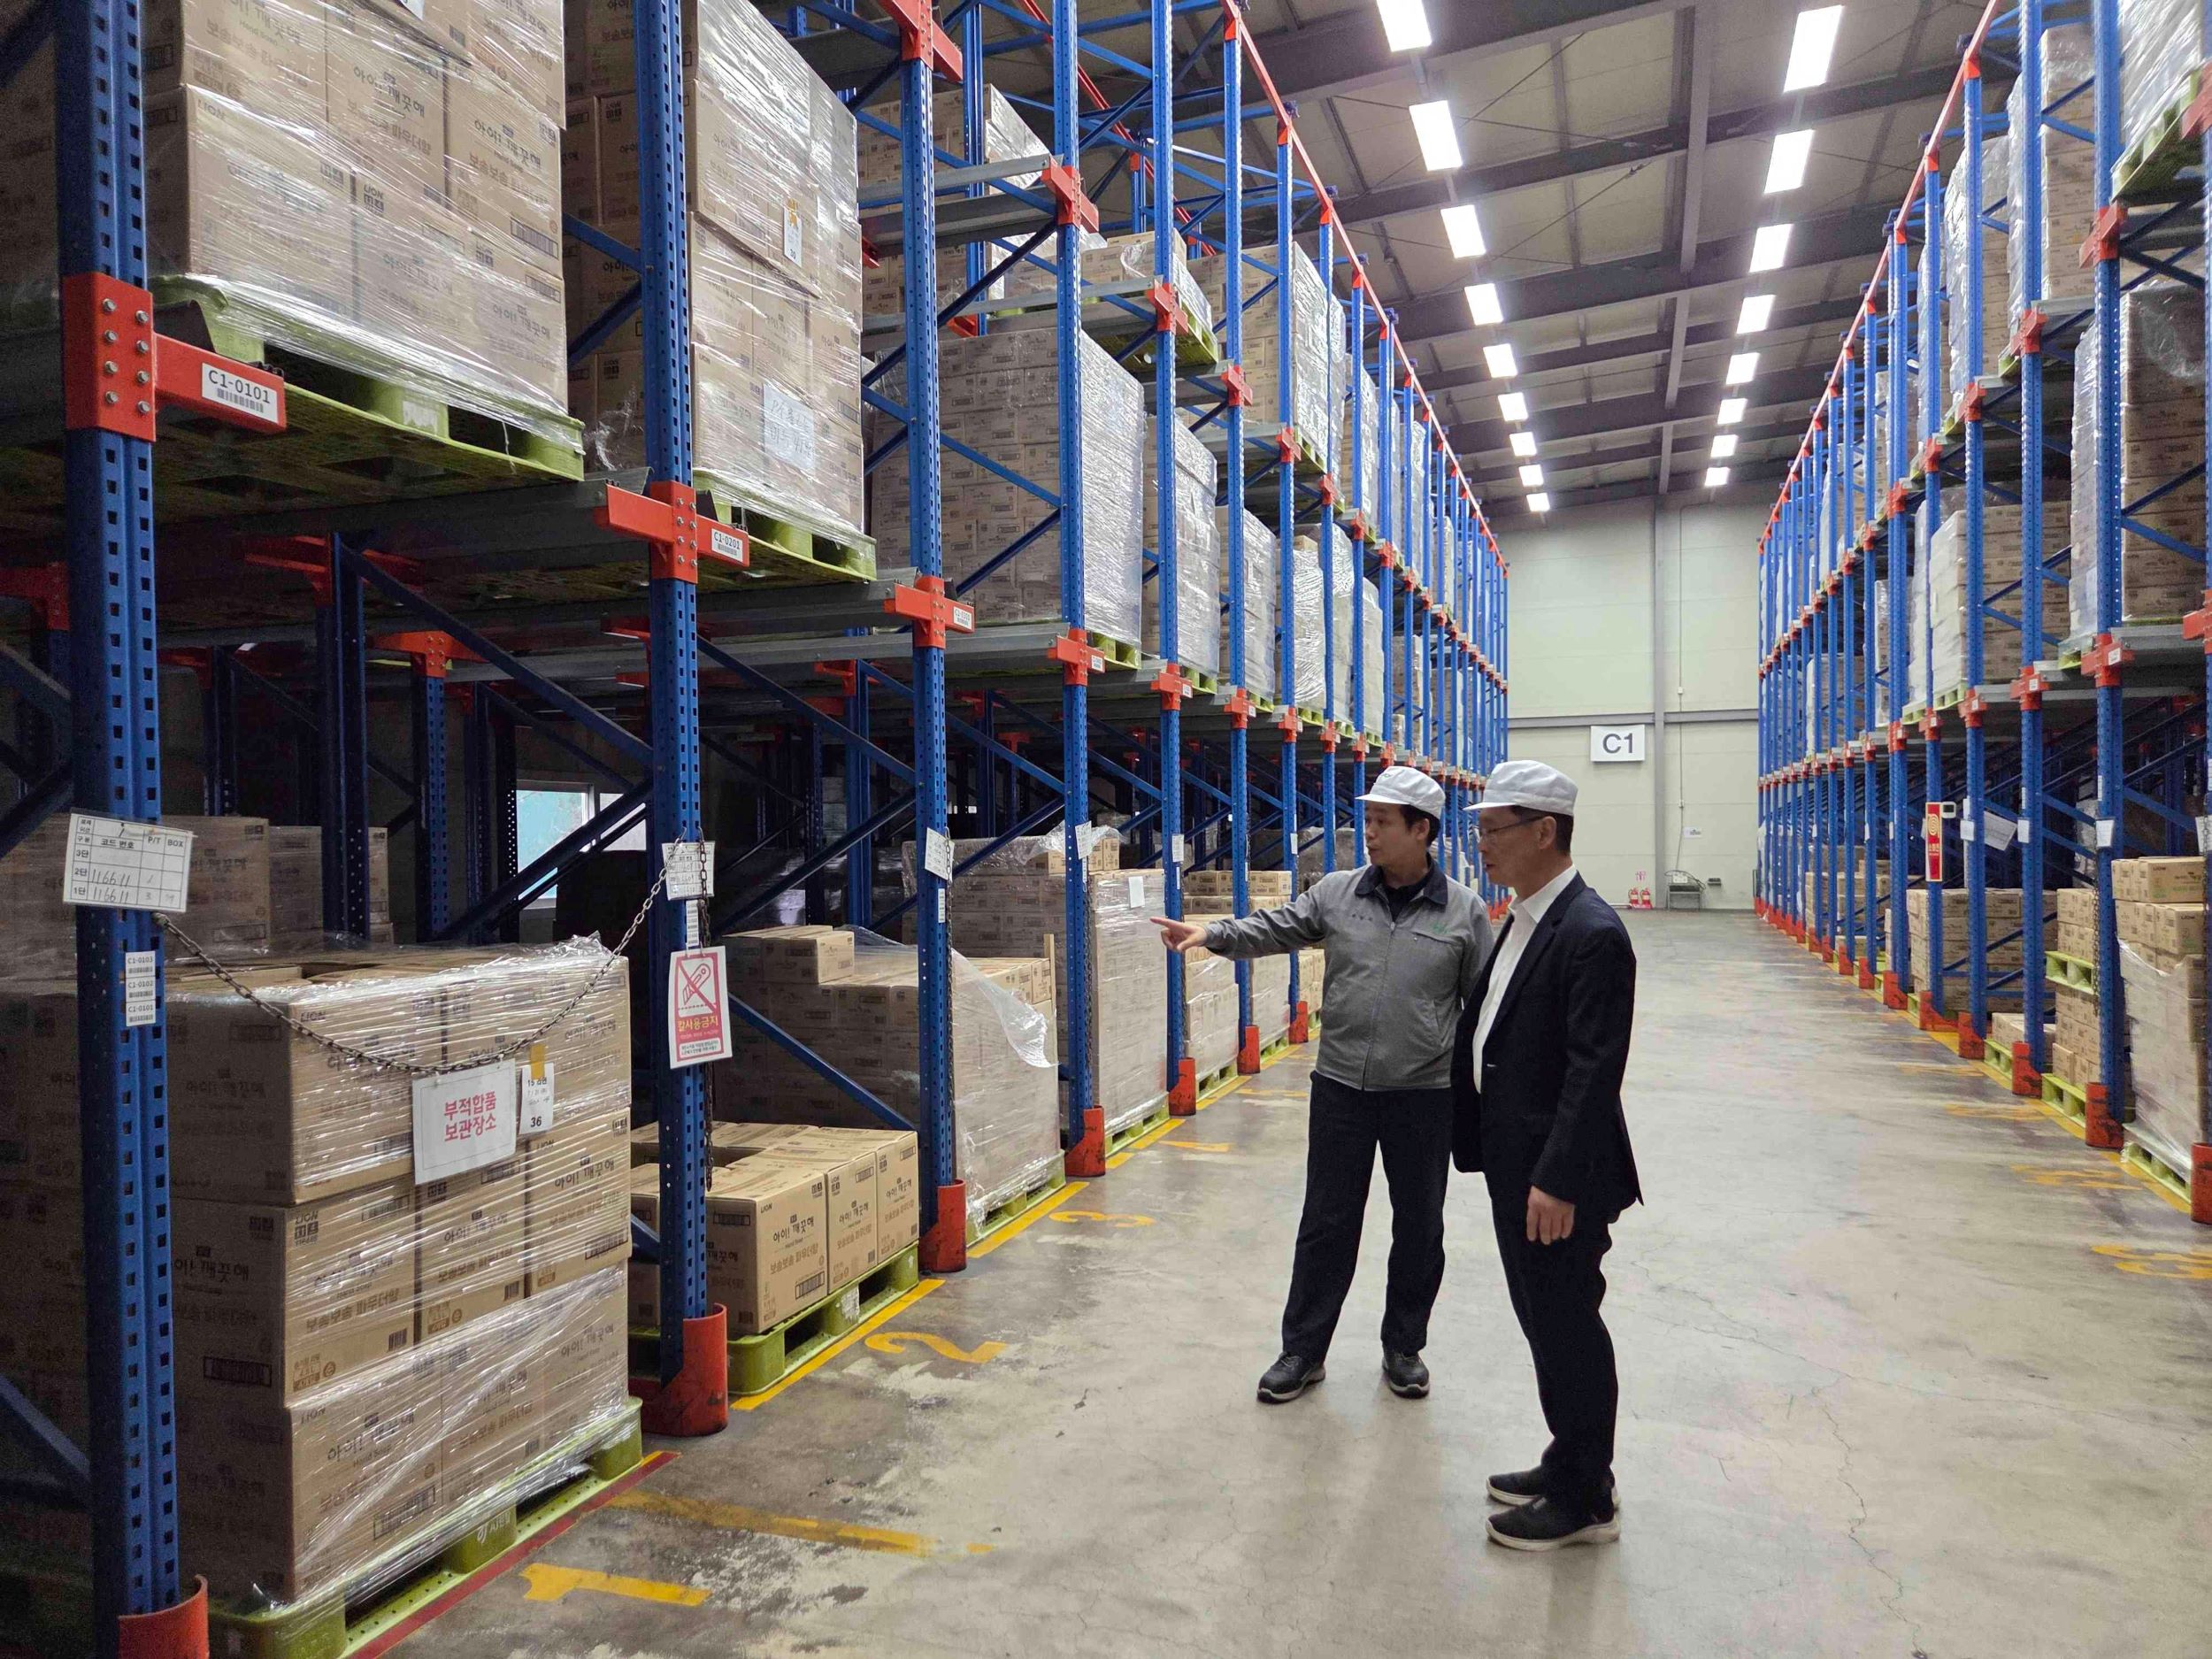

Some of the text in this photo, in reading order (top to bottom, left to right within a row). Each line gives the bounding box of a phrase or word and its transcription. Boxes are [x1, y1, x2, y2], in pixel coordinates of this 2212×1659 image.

[364, 183, 384, 200] LION
[208, 369, 271, 404] C1-0101
[713, 531, 741, 550] C1-0201
[1602, 732, 1633, 754] C1
[101, 838, 135, 849] 코드 번호
[147, 836, 162, 845] P/T
[167, 838, 184, 849] BOX
[76, 848, 89, 858] 3단
[74, 867, 88, 877] 2단
[73, 886, 86, 896] 1단
[127, 1004, 153, 1013] C1-0101
[678, 1015, 719, 1033] 칼사용금지
[443, 1090, 497, 1121] 부적합품
[443, 1114, 496, 1142] 보관장소
[530, 1116, 542, 1128] 36
[554, 1158, 615, 1188] 아이! 깨끗해
[295, 1210, 319, 1225] LION
[760, 1202, 772, 1214] LION
[1048, 1210, 1157, 1229] 3
[773, 1216, 815, 1243] 아이! 깨끗해
[770, 1241, 819, 1275] 보송보송 파우더향
[199, 1258, 250, 1283] 깨끗해
[305, 1287, 400, 1329] 보송보송 파우더향
[864, 1331, 1009, 1364] 2
[327, 1436, 363, 1462] 아이!
[517, 1563, 711, 1608] 1
